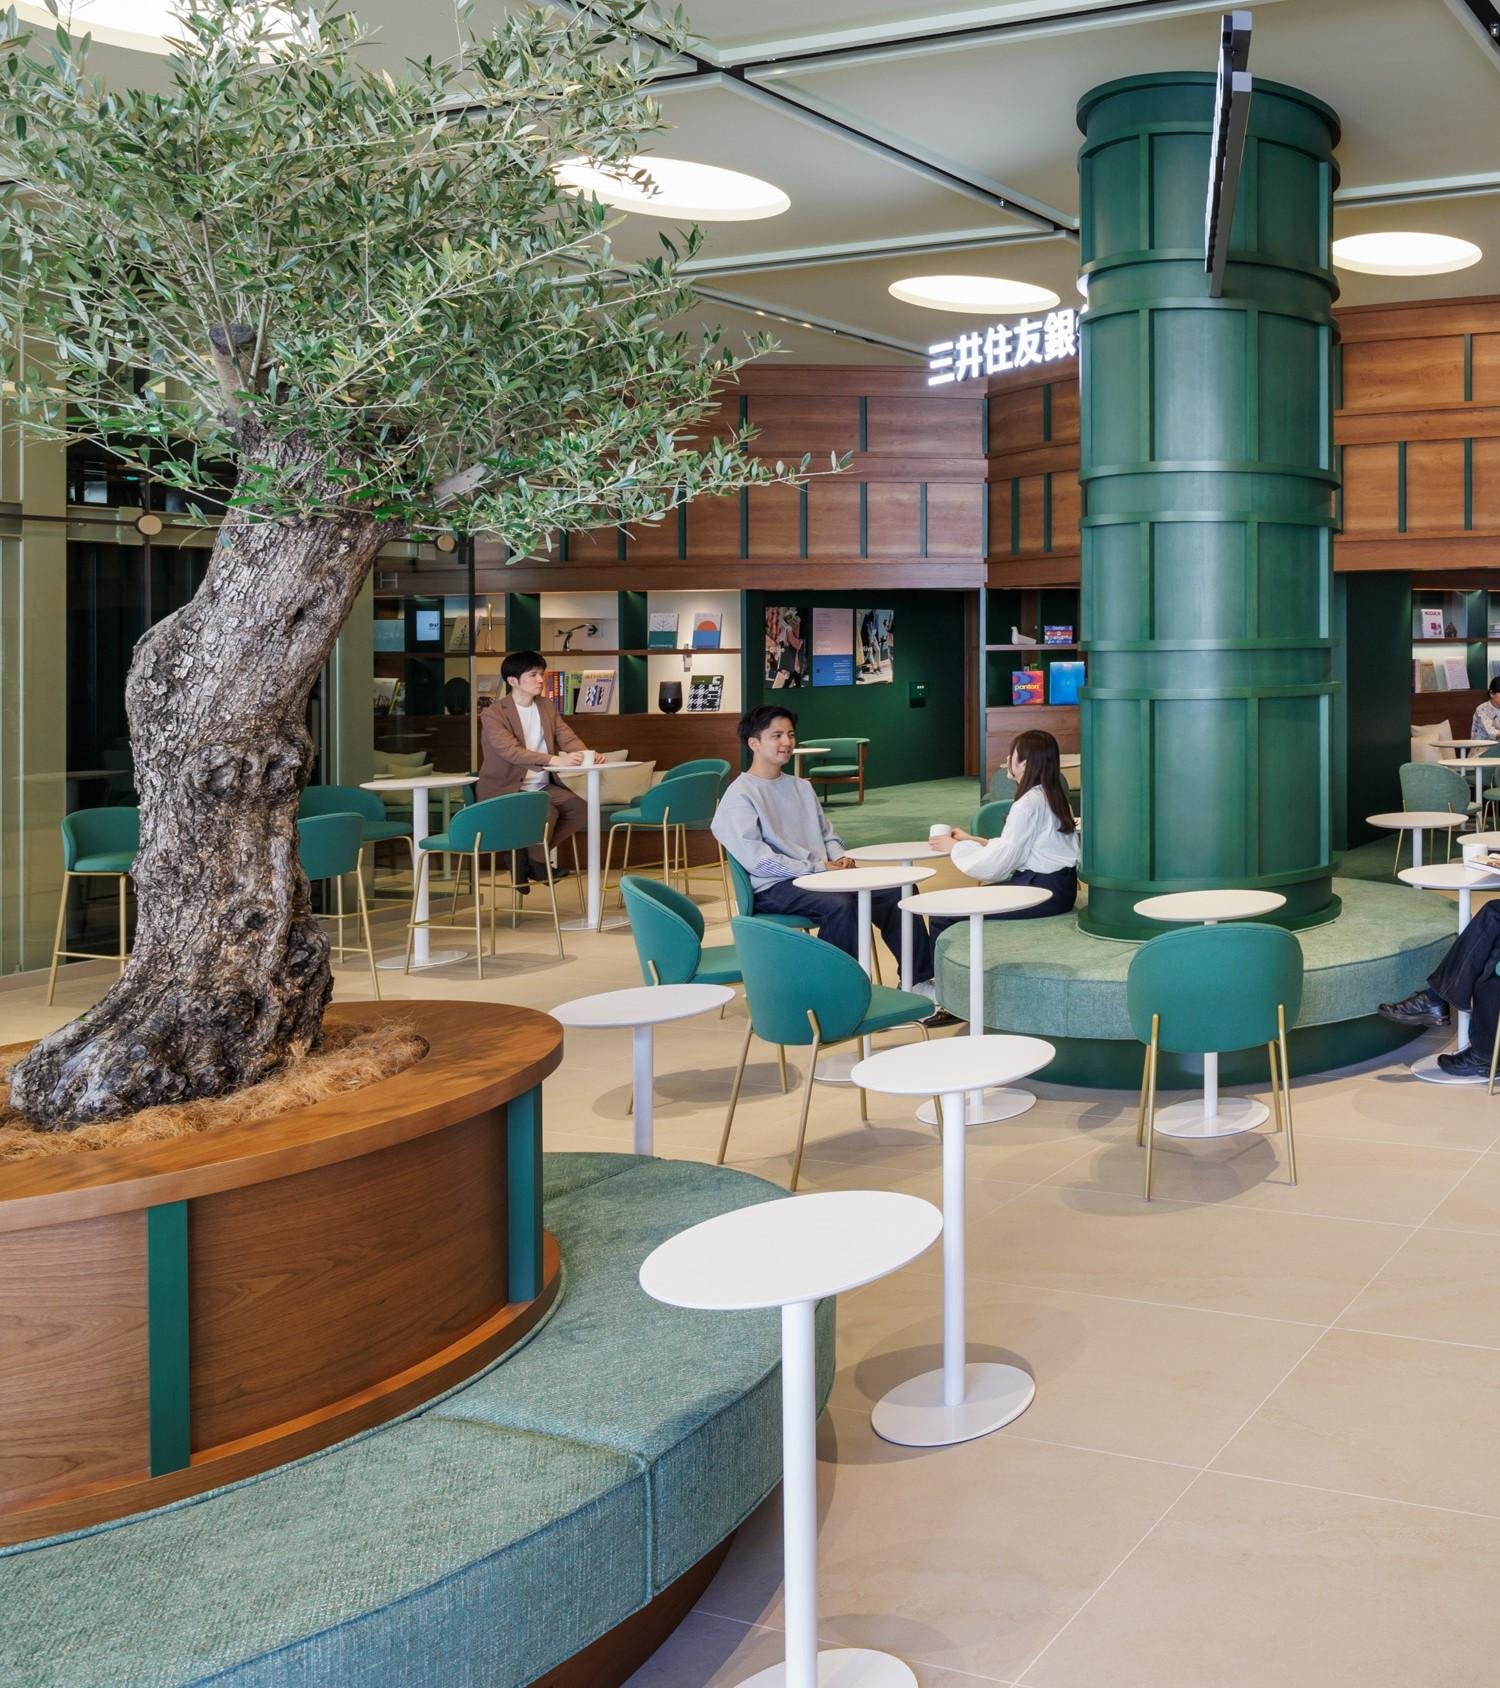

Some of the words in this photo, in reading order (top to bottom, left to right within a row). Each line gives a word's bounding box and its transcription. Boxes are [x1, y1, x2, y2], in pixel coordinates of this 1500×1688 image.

[928, 305, 1088, 386] 三井住友銀
